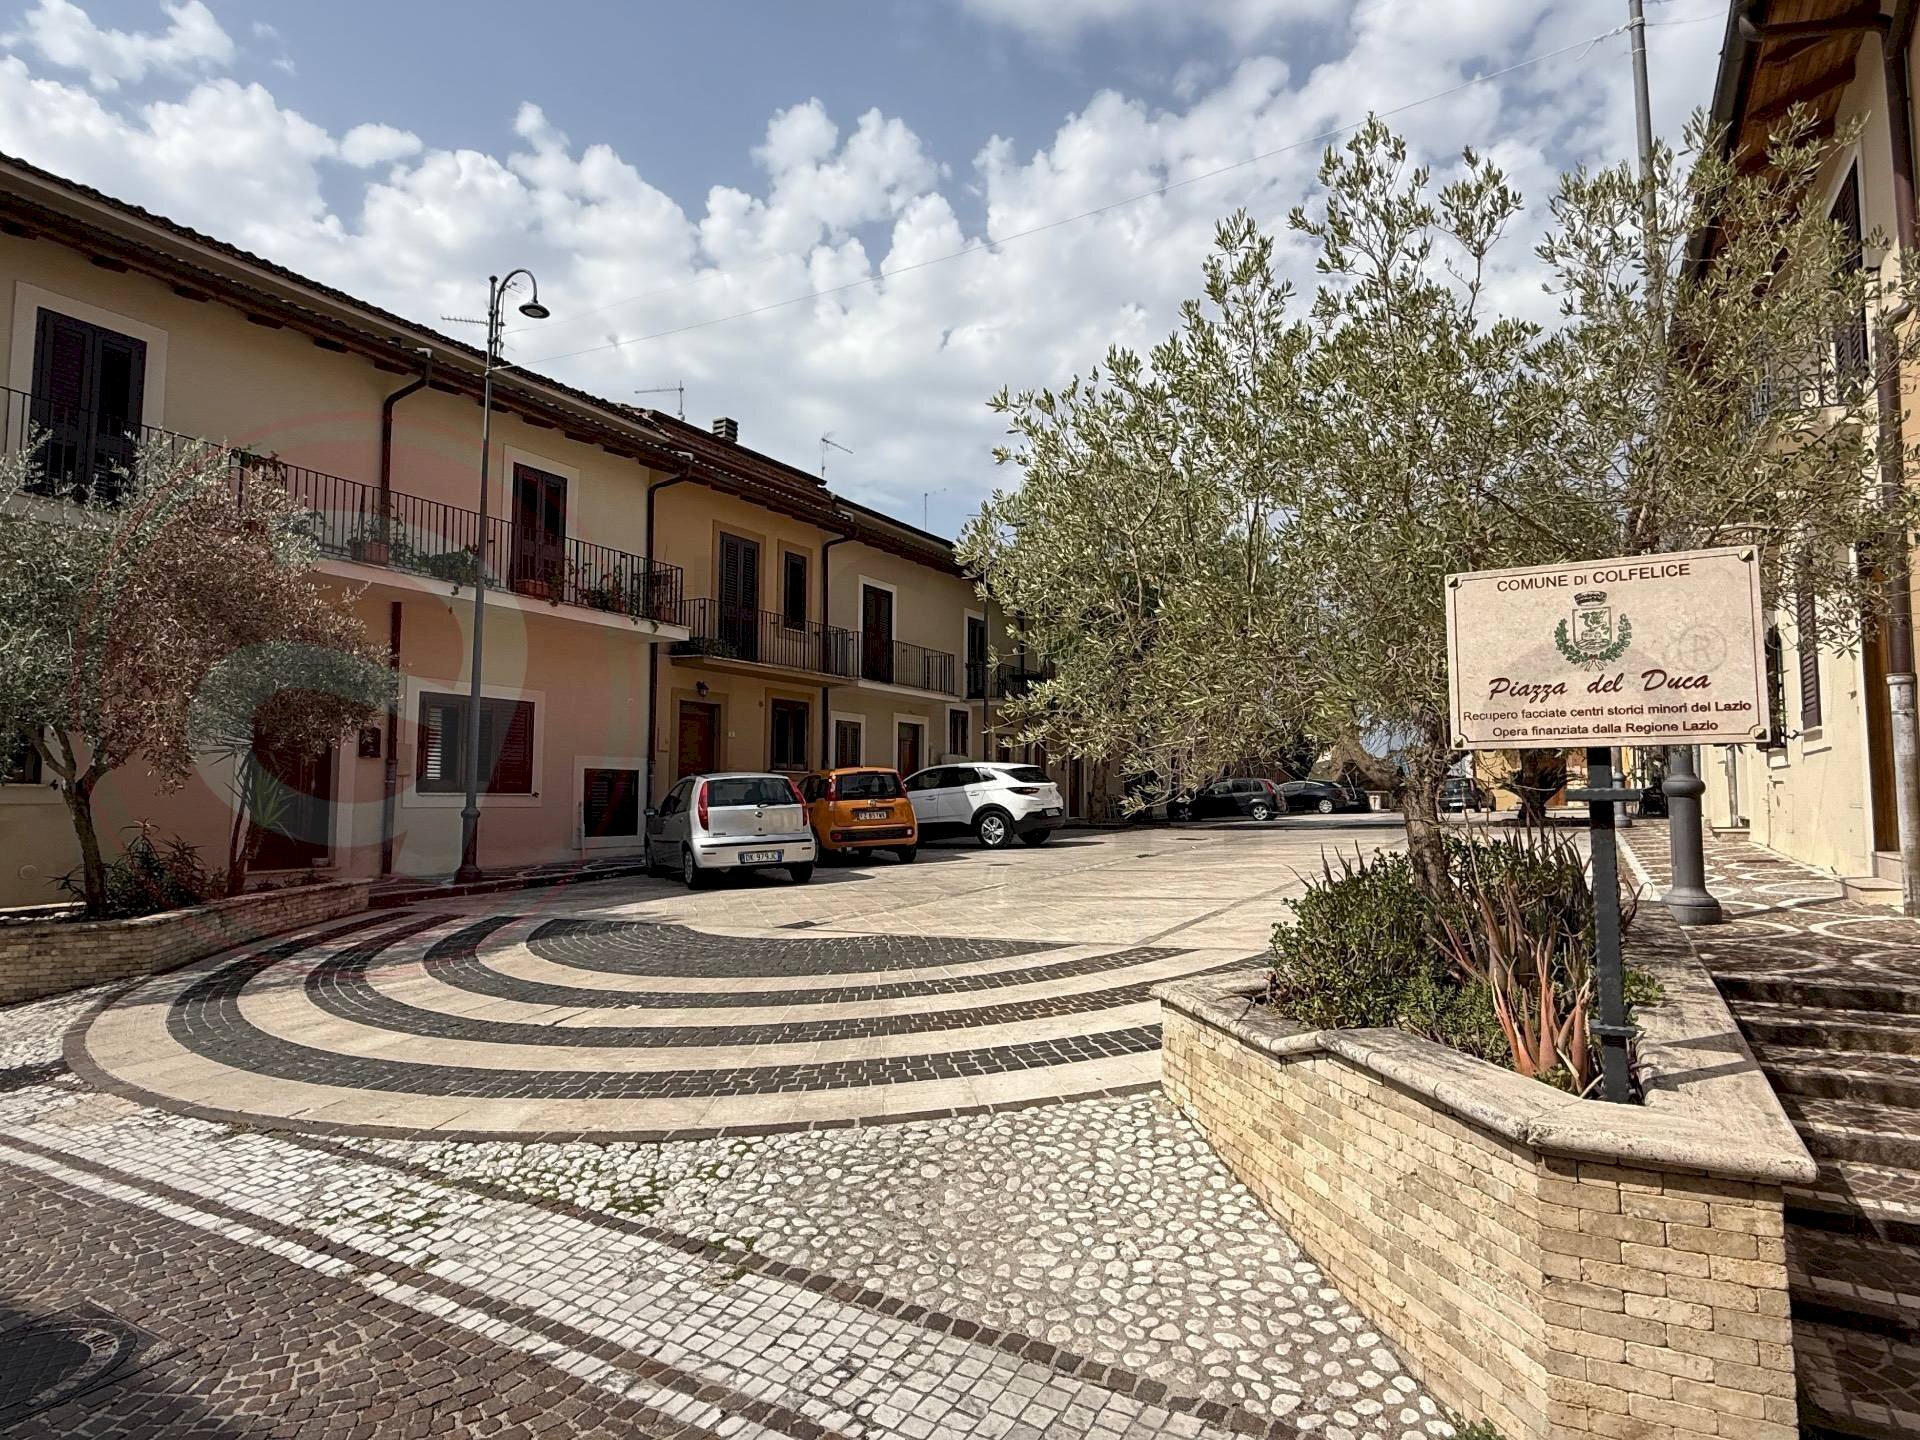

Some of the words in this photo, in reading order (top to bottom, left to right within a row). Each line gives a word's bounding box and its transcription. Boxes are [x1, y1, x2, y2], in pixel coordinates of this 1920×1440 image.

[1496, 574, 1568, 592] COMUNE
[1574, 575, 1587, 585] DI
[1592, 563, 1690, 583] COLFELICE
[1489, 678, 1567, 703] Piazza
[1587, 671, 1624, 694] del
[1641, 668, 1712, 691] Duca
[1464, 712, 1518, 723] Recupero
[1521, 709, 1567, 719] facciate
[1570, 706, 1603, 717] centri
[1607, 705, 1644, 715] storici
[1648, 703, 1687, 714] minori
[1691, 702, 1711, 712] del
[1715, 700, 1752, 712] Lazio
[1493, 727, 1528, 738] Opera
[1531, 725, 1589, 735] finanziata
[1592, 724, 1622, 734] dalla
[1625, 722, 1679, 735] Regione
[1683, 720, 1718, 731] Lazio
